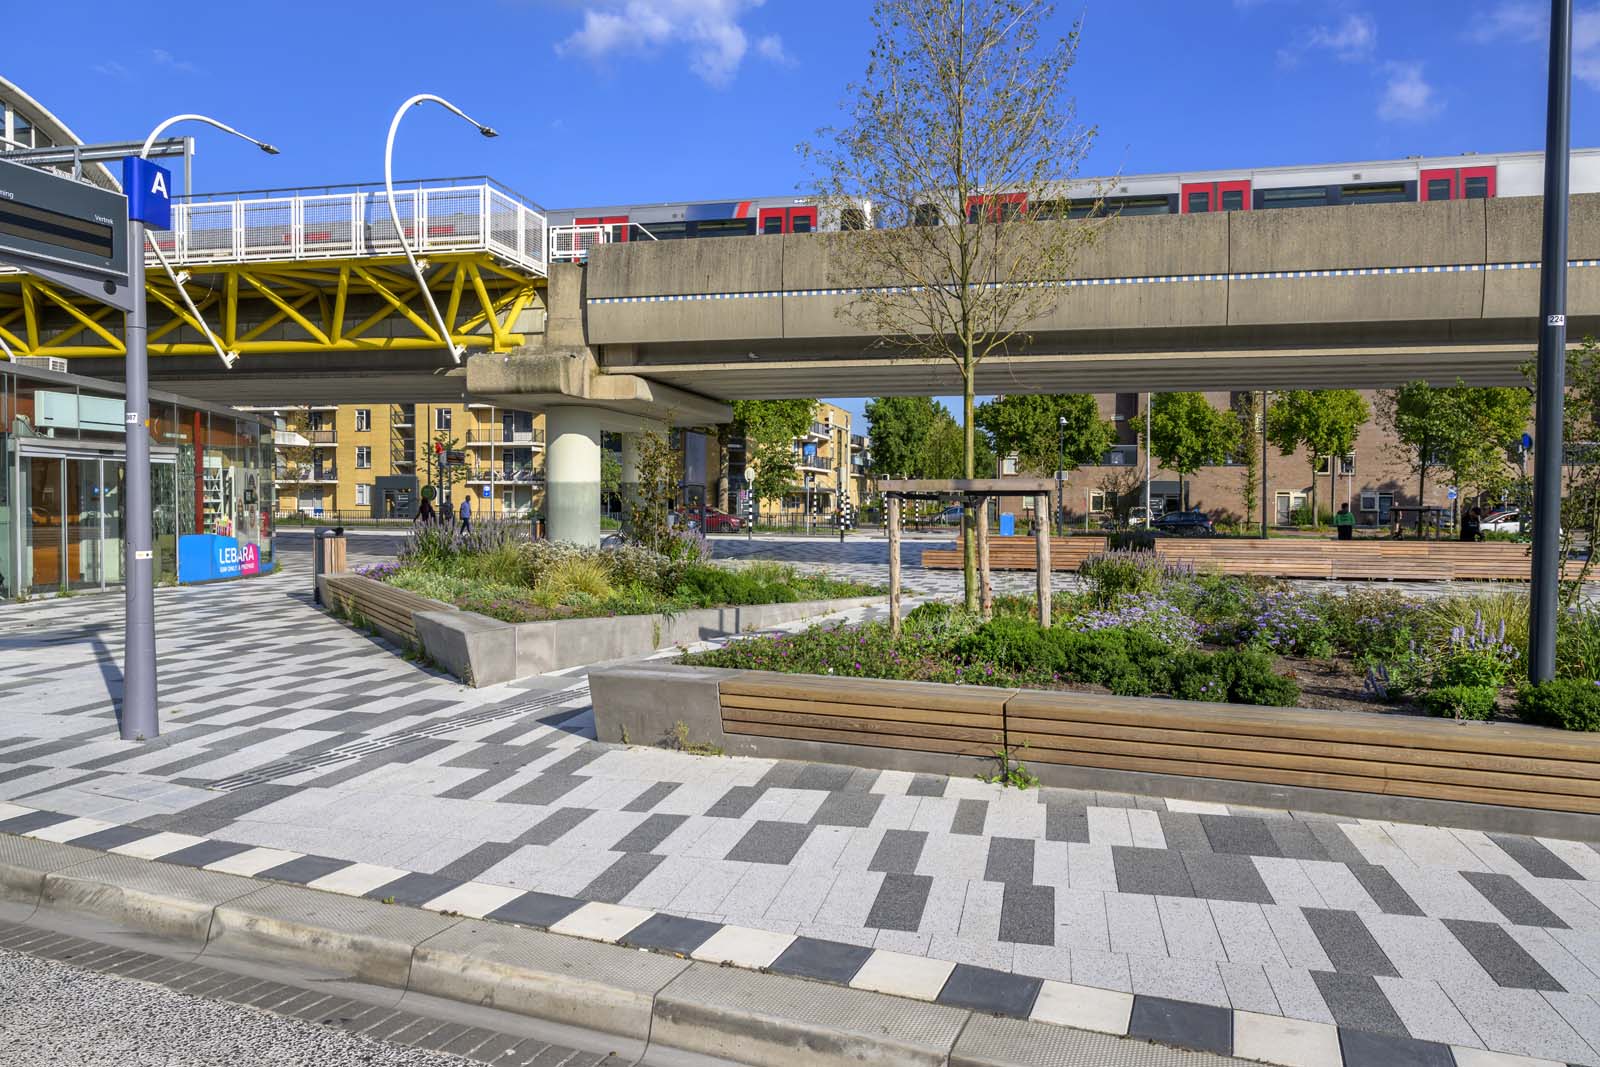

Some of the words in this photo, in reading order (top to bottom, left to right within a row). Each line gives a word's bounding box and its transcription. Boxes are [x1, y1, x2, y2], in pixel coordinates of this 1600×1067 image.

[151, 171, 169, 199] A
[1549, 315, 1563, 323] 224
[219, 545, 255, 565] LEBARA
